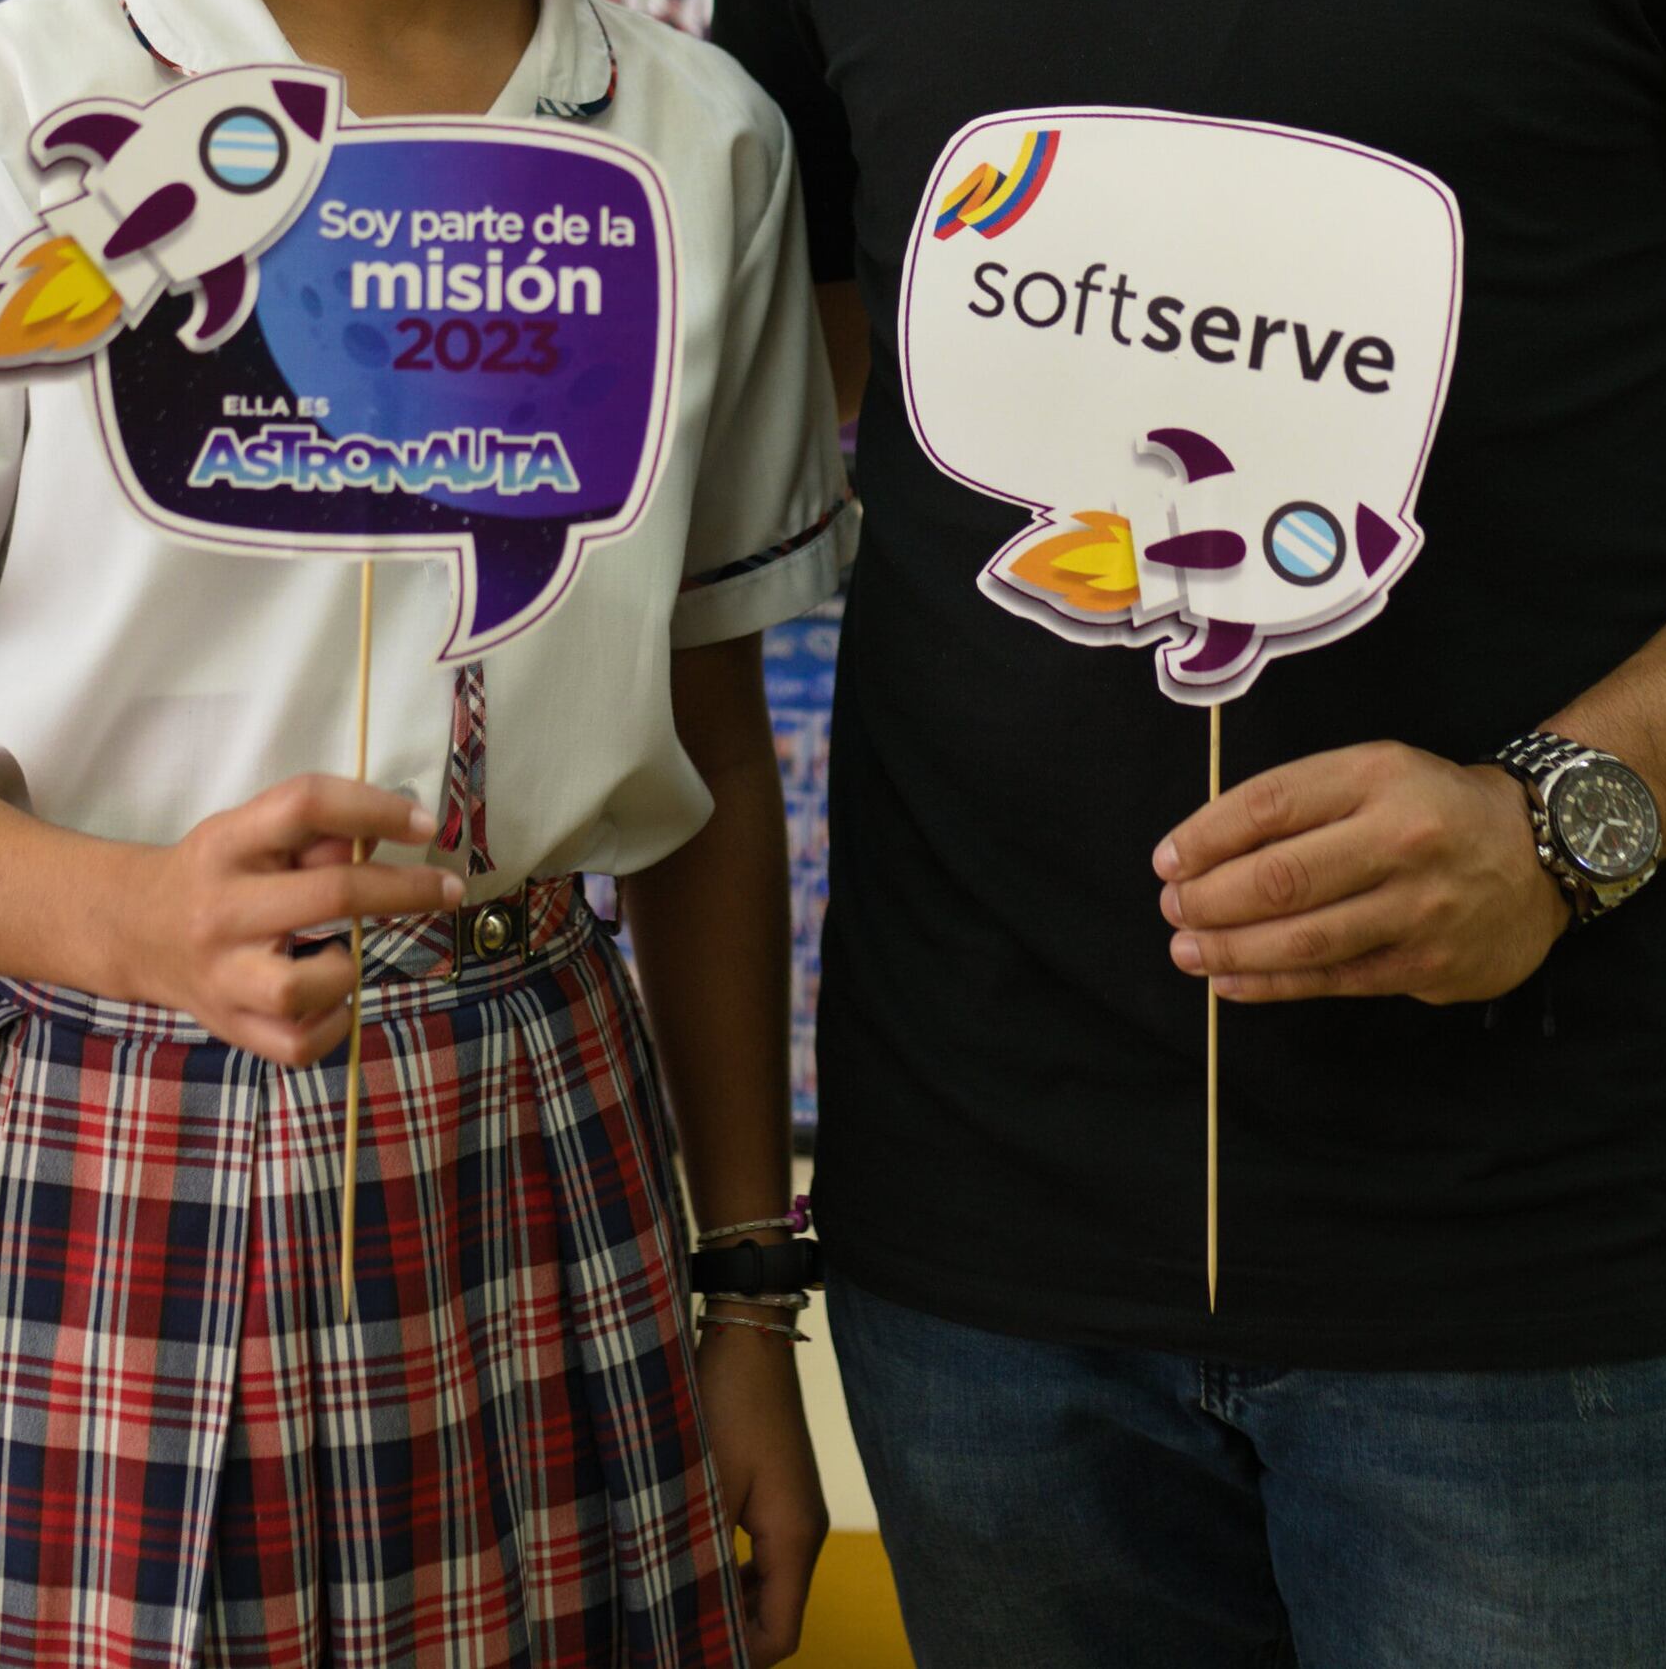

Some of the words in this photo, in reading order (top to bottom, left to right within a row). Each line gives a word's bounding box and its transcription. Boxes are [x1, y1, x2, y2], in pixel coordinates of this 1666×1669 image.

[318, 200, 402, 247] Soy
[410, 205, 523, 248] parte
[533, 204, 591, 245] de
[599, 206, 636, 246] la
[350, 248, 603, 315] misión
[392, 318, 561, 375] 2023
[967, 261, 1395, 394] softserve
[222, 395, 291, 418] ELLA
[297, 396, 331, 419] ES
[186, 425, 581, 496] ASTRONAUTA
